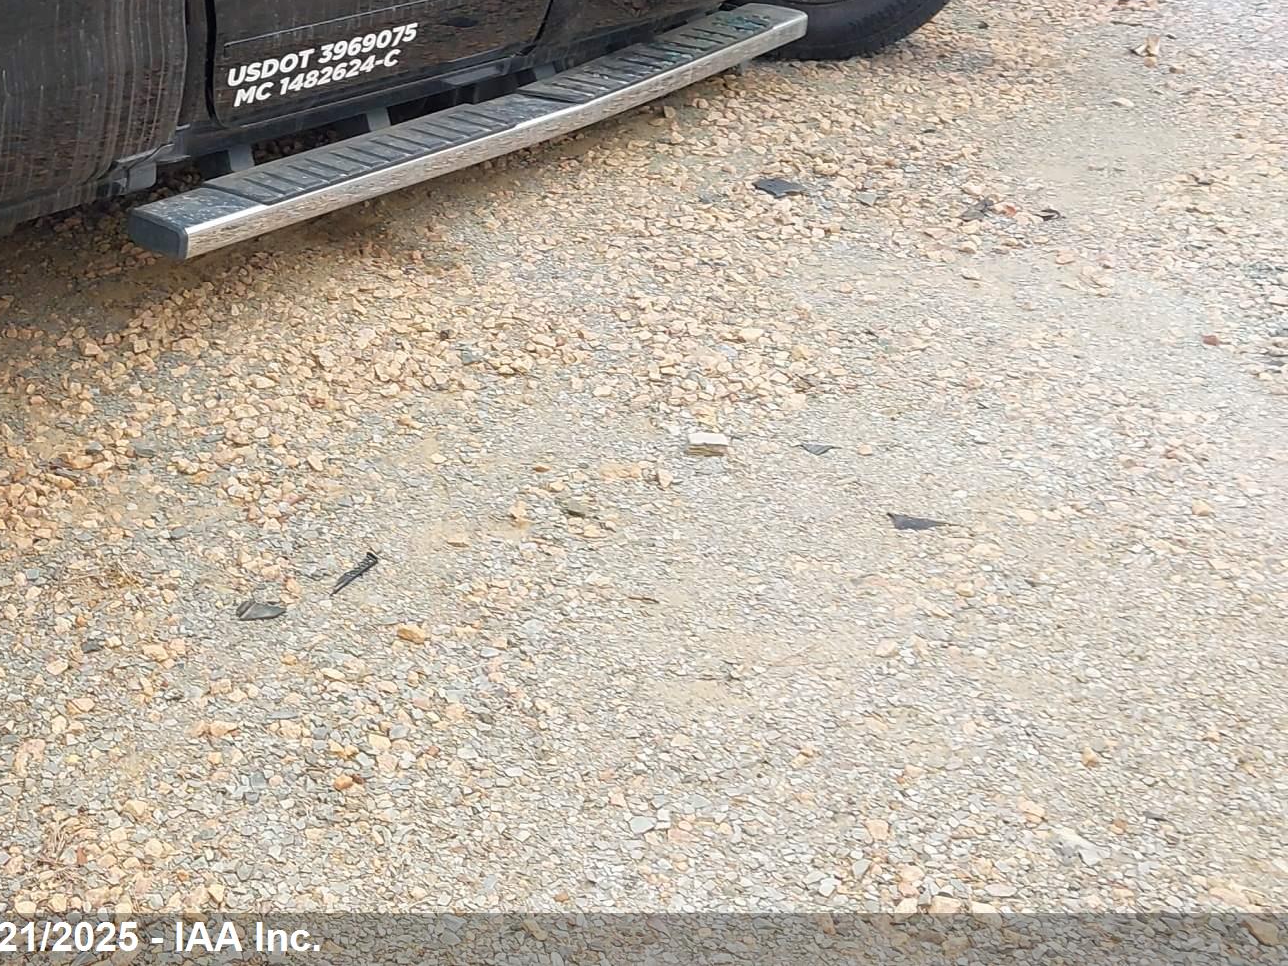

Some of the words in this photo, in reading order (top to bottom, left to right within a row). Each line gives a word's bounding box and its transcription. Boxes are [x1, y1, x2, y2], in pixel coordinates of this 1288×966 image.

[227, 48, 315, 87] USDOT
[317, 22, 419, 64] 3969075
[233, 81, 273, 107] MC
[279, 49, 402, 96] 1482624-C
